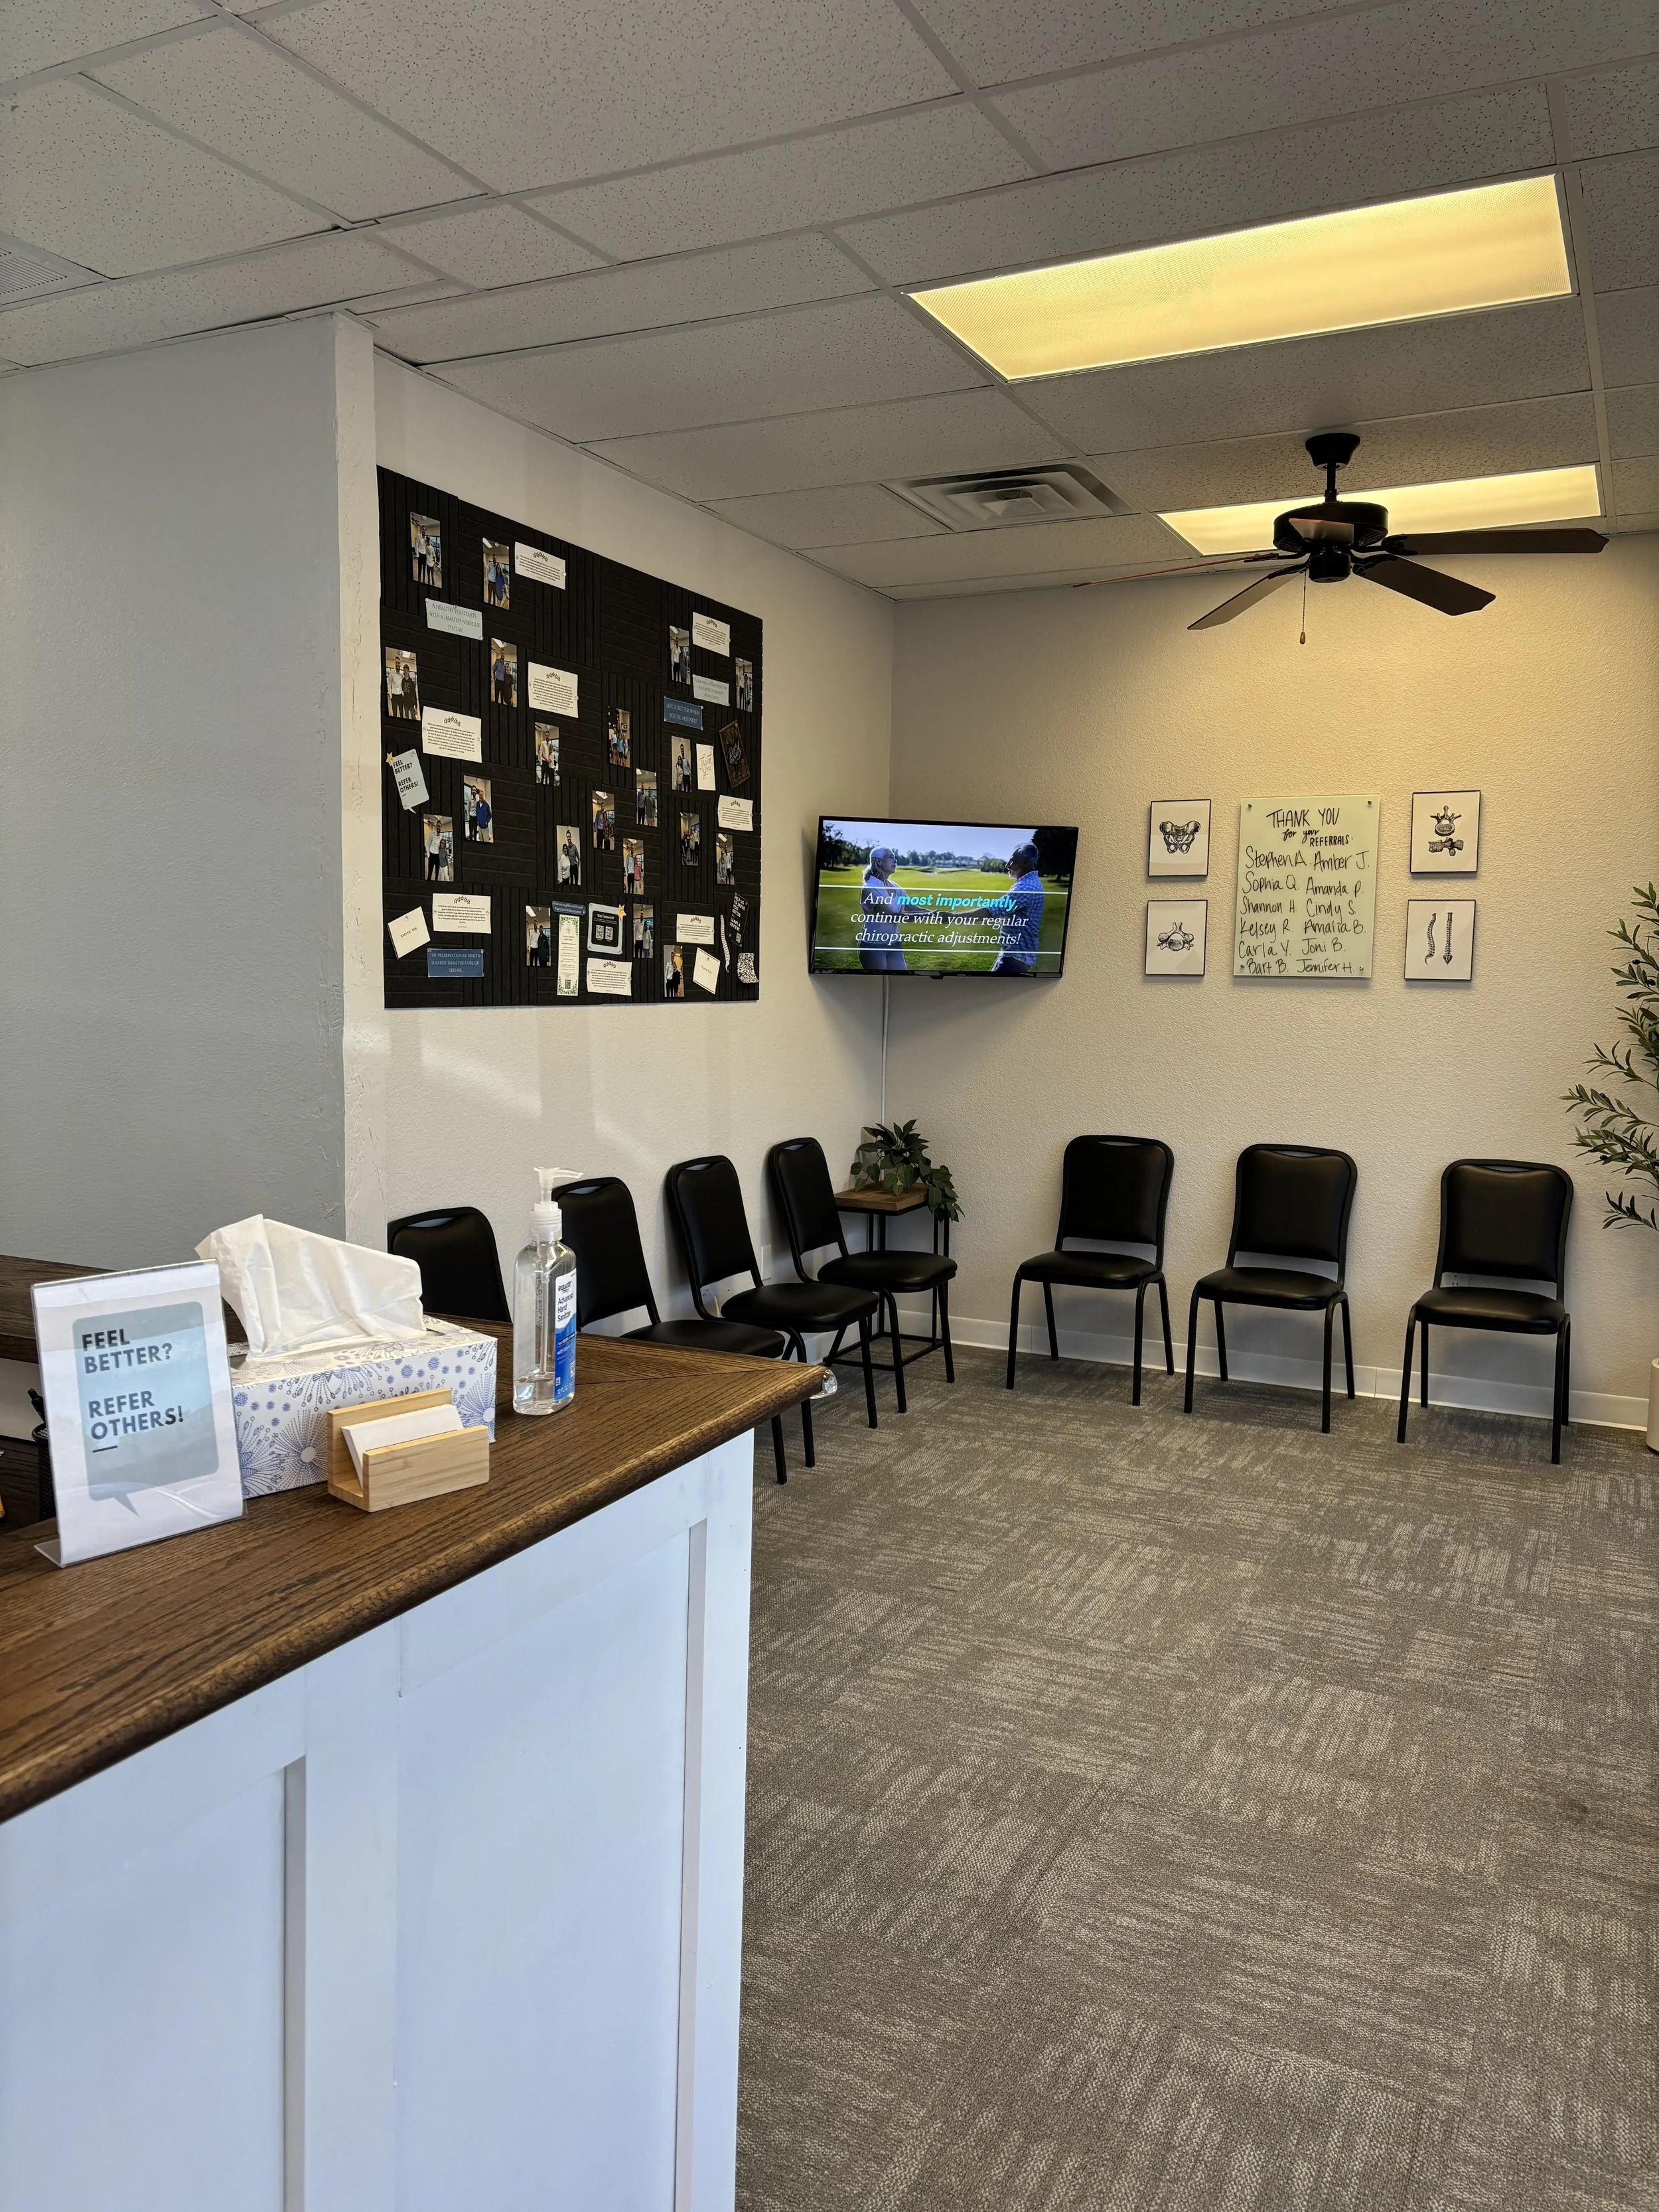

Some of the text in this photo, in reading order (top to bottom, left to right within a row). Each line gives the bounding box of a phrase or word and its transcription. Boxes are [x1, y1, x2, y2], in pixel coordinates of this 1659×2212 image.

[395, 763, 413, 774] BETTER?
[398, 776, 411, 787] REFER
[400, 780, 419, 792] OTHERS!
[1266, 808, 1340, 828] THANK YOU
[1283, 829, 1319, 843] for your
[1246, 846, 1293, 869] Stephen
[1313, 851, 1352, 871] Amber
[1242, 871, 1283, 893] Sophia
[1306, 877, 1348, 895] Amanda
[862, 892, 1017, 911] And most importantly,
[1240, 896, 1282, 915] Shannon
[851, 911, 1029, 930] continue with your regular
[1307, 899, 1342, 924] Cindy
[1240, 917, 1275, 943] Kelsey
[1305, 919, 1351, 935] Amalia
[855, 928, 1021, 947] chiropractic adjustments!
[1302, 938, 1326, 956] Joni
[1239, 941, 1277, 958] Carla
[1247, 958, 1271, 975] Bart
[1296, 958, 1340, 973] Jennifer
[557, 1303, 567, 1313] Hand
[82, 1329, 130, 1352] FEEL
[84, 1343, 173, 1374] BETTER?
[88, 1390, 155, 1418] REFER
[91, 1406, 183, 1440] OTHERS!
